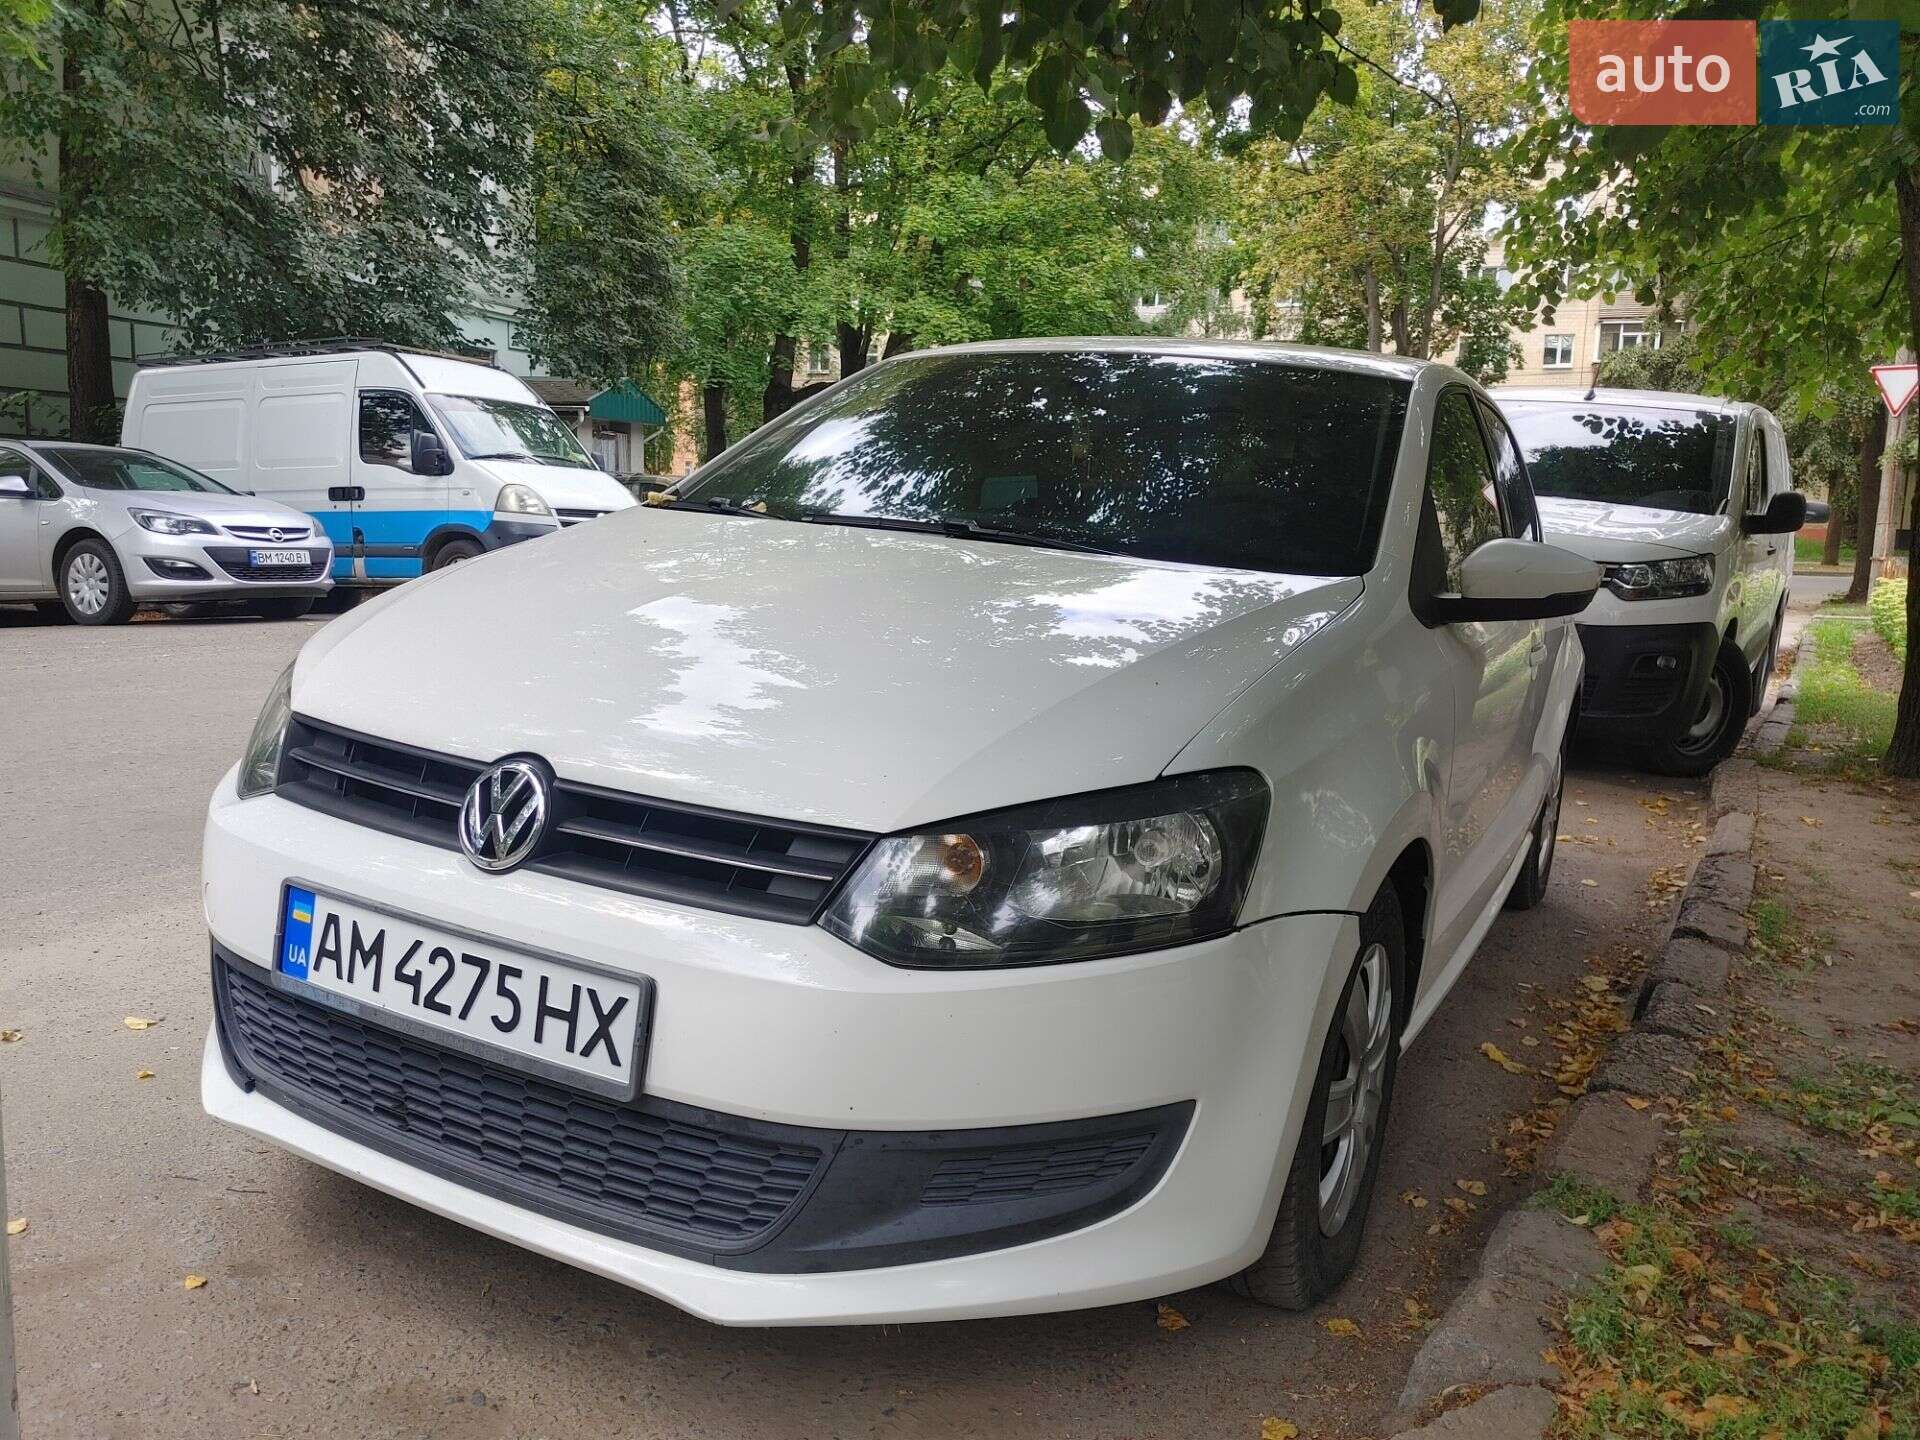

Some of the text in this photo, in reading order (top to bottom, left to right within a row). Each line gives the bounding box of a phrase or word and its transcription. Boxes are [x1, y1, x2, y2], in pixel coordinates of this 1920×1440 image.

[257, 552, 273, 563] BM
[274, 552, 295, 563] 1240
[289, 943, 307, 967] UA
[313, 912, 386, 993] AM
[394, 939, 523, 1033] 4275
[534, 975, 629, 1067] HX
